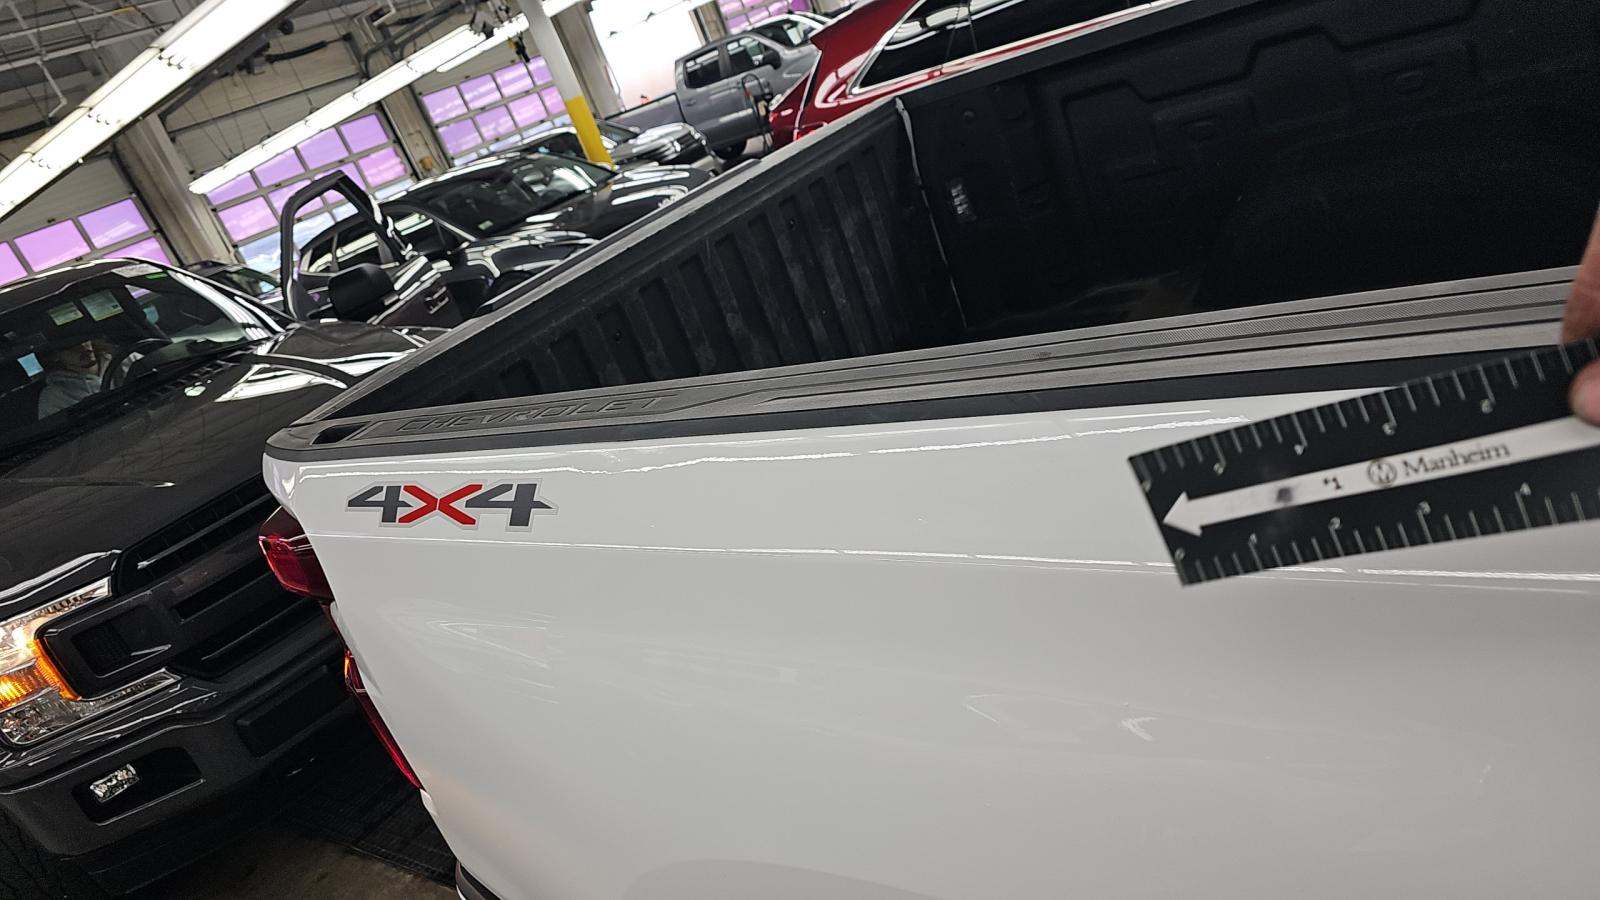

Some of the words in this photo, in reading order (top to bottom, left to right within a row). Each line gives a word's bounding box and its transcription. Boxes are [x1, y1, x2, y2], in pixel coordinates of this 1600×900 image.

[395, 394, 677, 432] CHEVROLET
[1402, 442, 1511, 478] Manheim
[347, 481, 556, 529] 4X4
